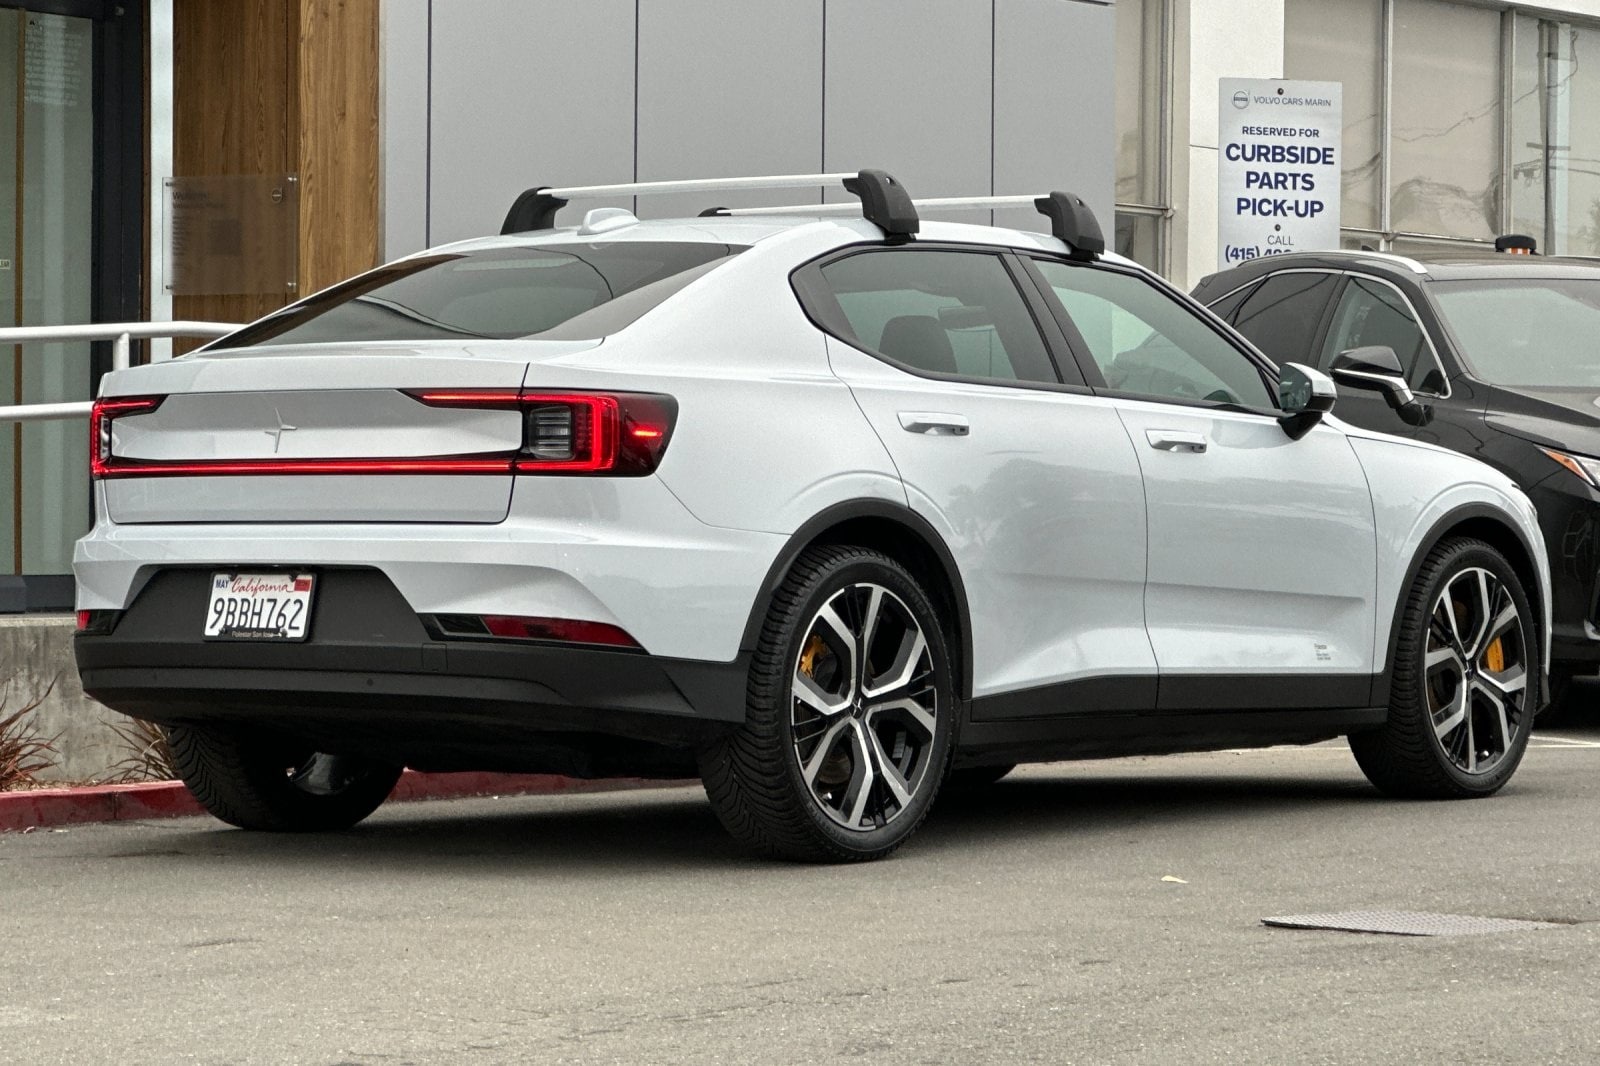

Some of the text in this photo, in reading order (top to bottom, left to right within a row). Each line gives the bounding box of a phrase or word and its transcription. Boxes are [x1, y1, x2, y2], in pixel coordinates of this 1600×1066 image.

[1253, 96, 1281, 105] VOLVO
[1281, 97, 1304, 106] CARS
[1304, 98, 1332, 107] MARIN
[1242, 126, 1320, 138] RESERVED FOR
[1225, 143, 1335, 165] CURBSIDE
[1245, 171, 1315, 191] PARTS
[1236, 197, 1324, 218] PICK-UP
[1267, 235, 1294, 246] CALL
[1225, 245, 1260, 263] (415)
[215, 579, 229, 588] MAY
[231, 576, 294, 598] California
[209, 597, 304, 630] 9BBH762
